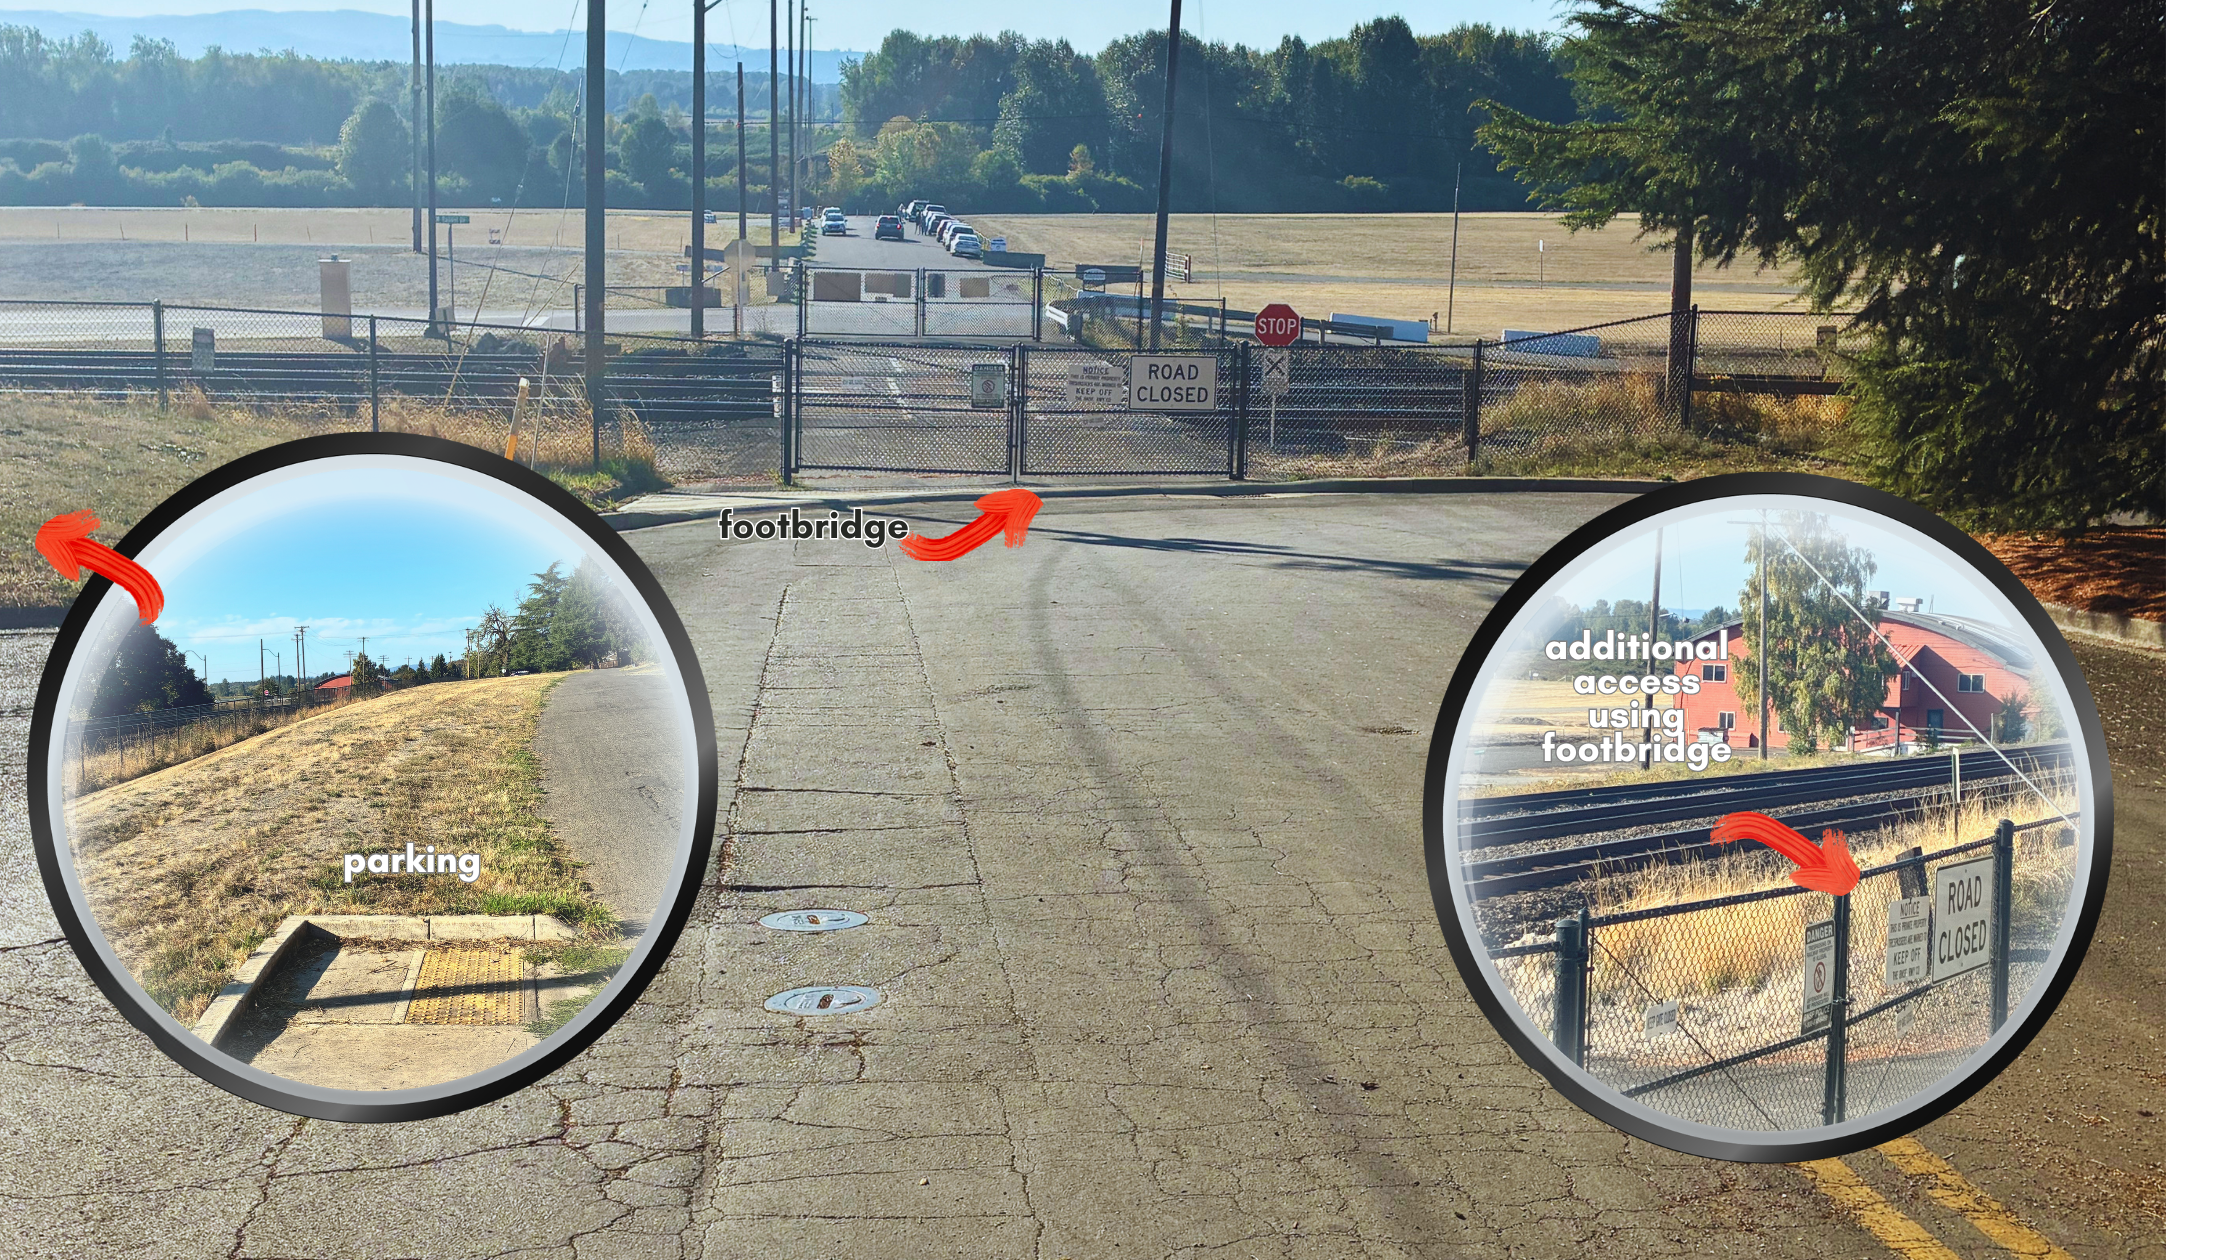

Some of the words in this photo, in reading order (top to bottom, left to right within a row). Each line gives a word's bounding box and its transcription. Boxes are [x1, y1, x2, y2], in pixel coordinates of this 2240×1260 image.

[1258, 318, 1296, 334] STOP
[1083, 366, 1109, 374] NOTICE
[1149, 364, 1198, 380] ROAD
[1137, 386, 1208, 402] CLOSED
[1948, 876, 1982, 915] ROAD
[1900, 901, 1920, 916] NOTICE
[1806, 924, 1833, 942] DANGER
[1939, 920, 1986, 964] CLOSED
[1894, 950, 1908, 966] KEEP
[1910, 947, 1921, 962] OFF
[1816, 1004, 1830, 1017] POLICE
